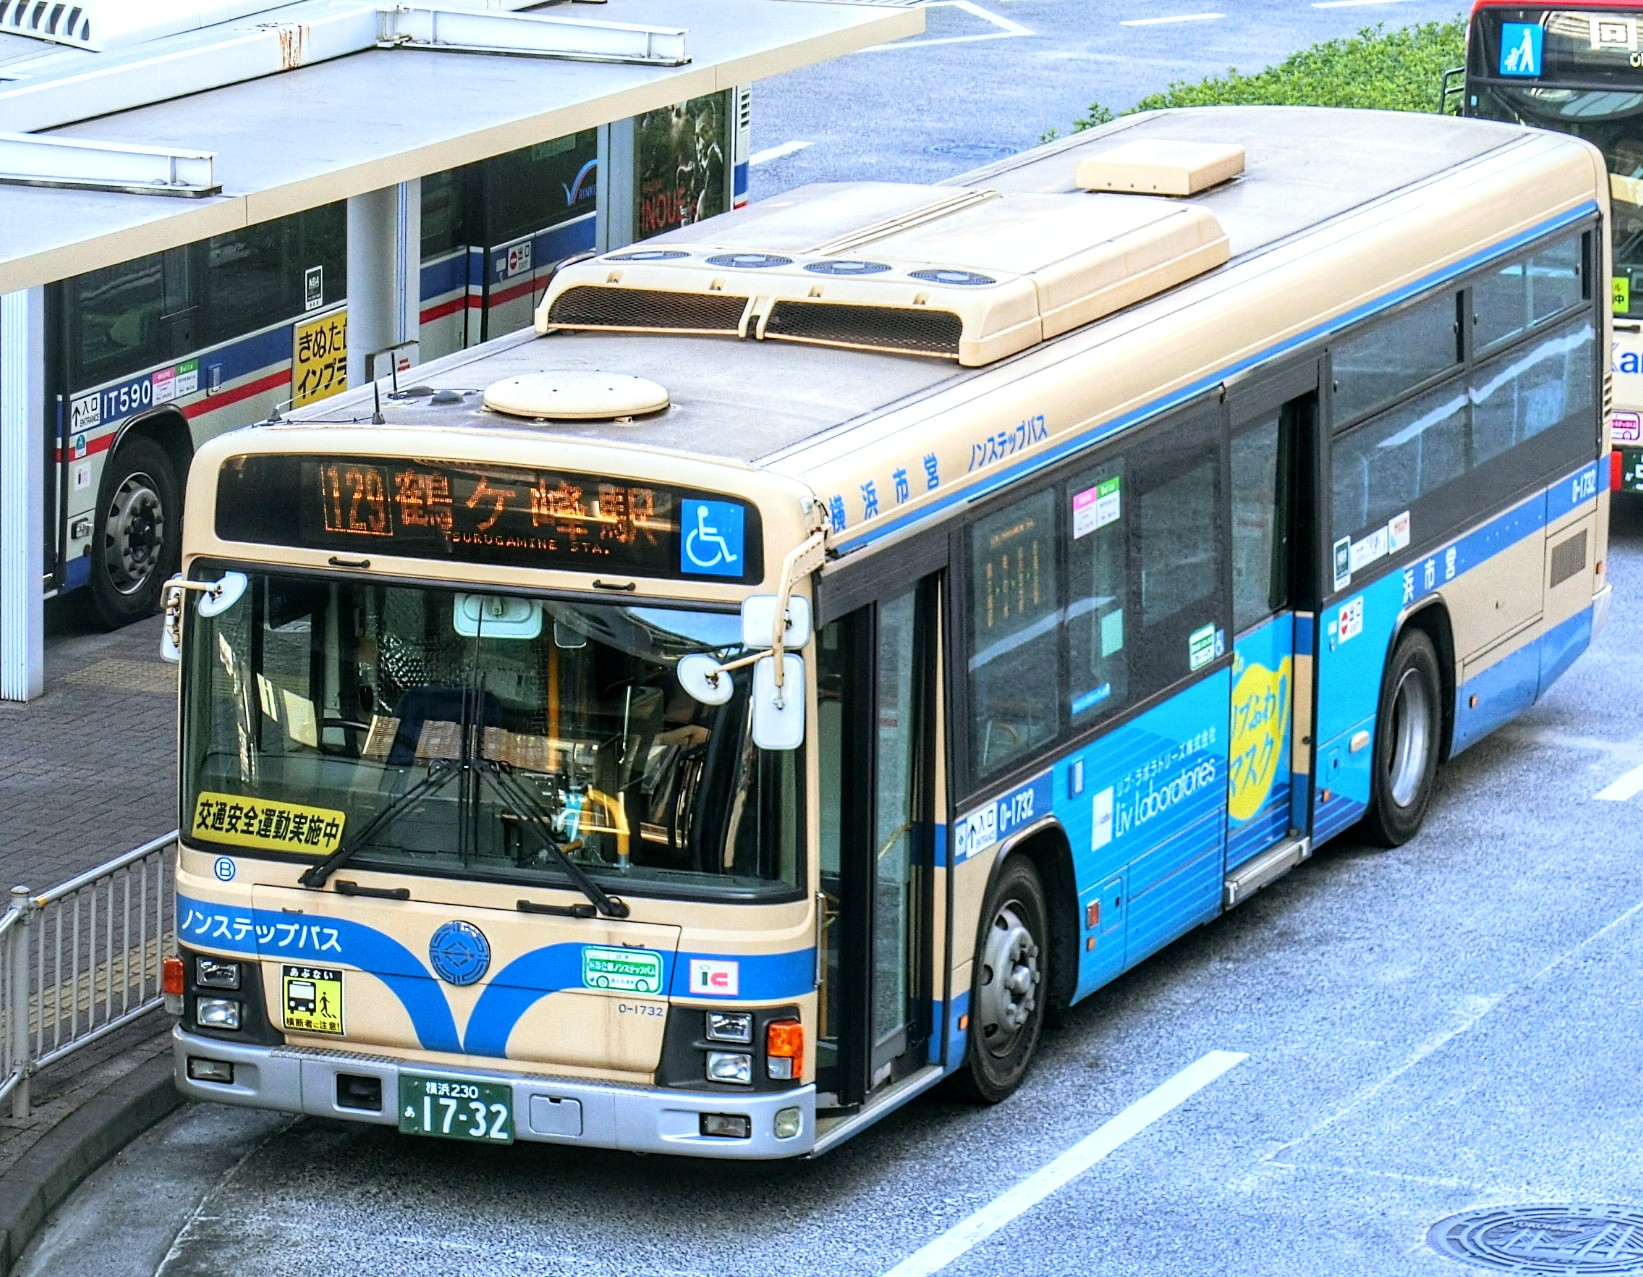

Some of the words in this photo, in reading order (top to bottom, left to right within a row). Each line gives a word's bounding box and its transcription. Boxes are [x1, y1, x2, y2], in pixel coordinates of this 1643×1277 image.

[82, 397, 98, 415] 入口
[103, 379, 151, 419] IT590
[79, 414, 100, 428] ENTRANCE
[968, 414, 1048, 473] ノンステップバス
[327, 468, 384, 530] 129
[829, 452, 940, 533] 横浜市営
[571, 541, 610, 555] STA.
[196, 799, 341, 848] 交通安全運動実施中
[181, 909, 343, 953] ノンステップバス
[289, 967, 334, 981] あぶない
[404, 1105, 416, 1119] あ
[423, 1096, 508, 1139] 17-32
